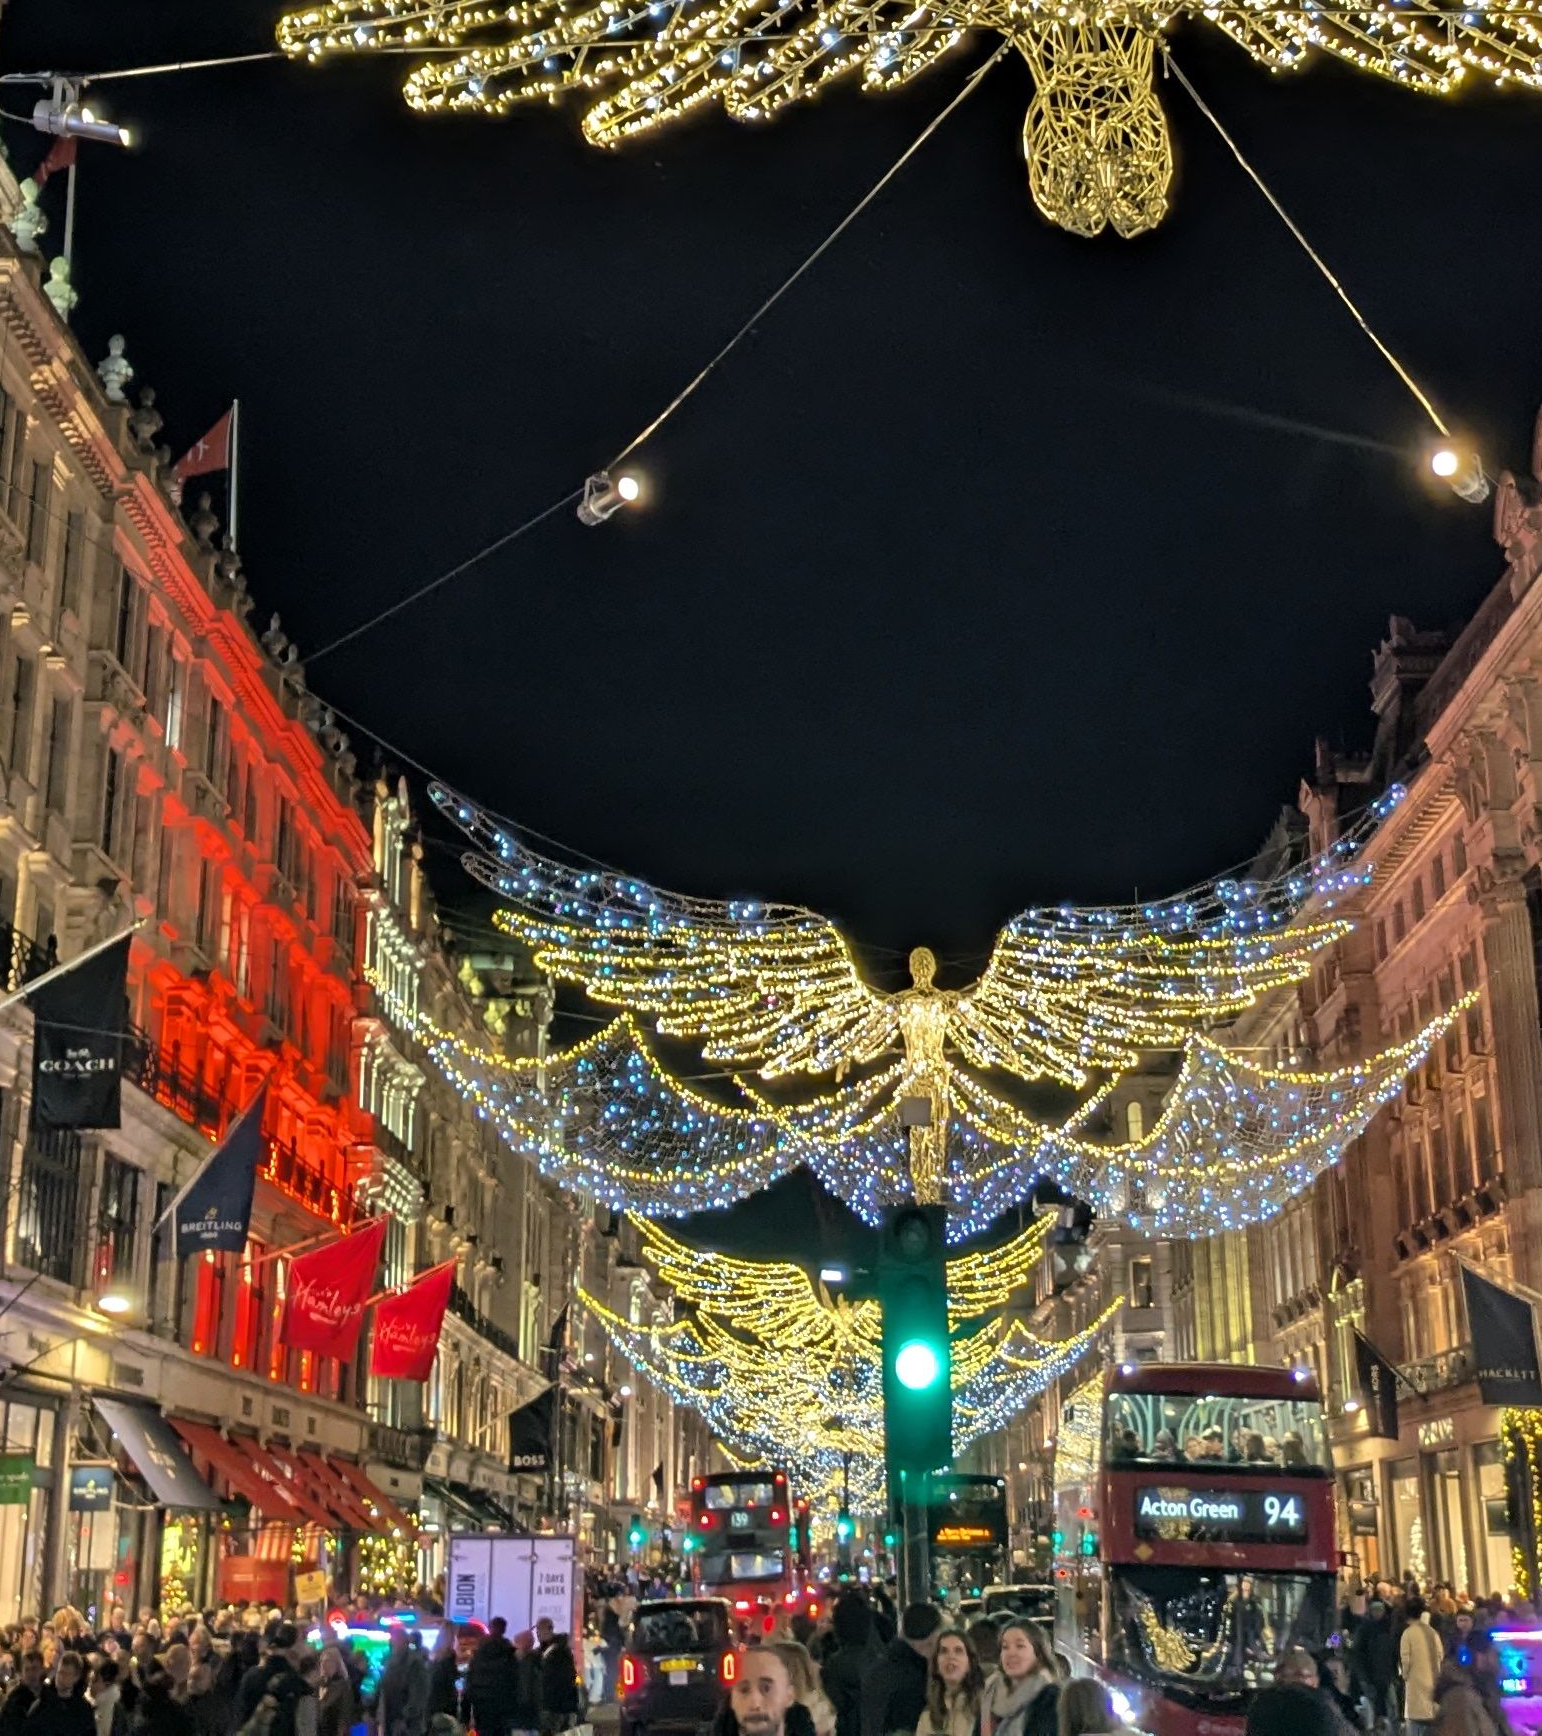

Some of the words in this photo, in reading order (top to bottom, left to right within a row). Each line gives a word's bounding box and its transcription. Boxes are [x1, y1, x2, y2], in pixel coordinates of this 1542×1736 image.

[39, 1058, 115, 1073] COACH
[181, 1221, 243, 1234] BREITLING
[291, 1269, 362, 1328] Hamleys
[377, 1316, 437, 1350] Hamleys
[1479, 1367, 1536, 1381] HACKETT
[514, 1454, 546, 1466] BOSS
[1140, 1496, 1187, 1517] Acton
[1190, 1498, 1239, 1519] Green
[1264, 1495, 1301, 1527] 94
[731, 1512, 749, 1528] 139
[546, 1573, 565, 1583] DAYS
[456, 1573, 475, 1618] LBION
[544, 1585, 565, 1596] WEEK
